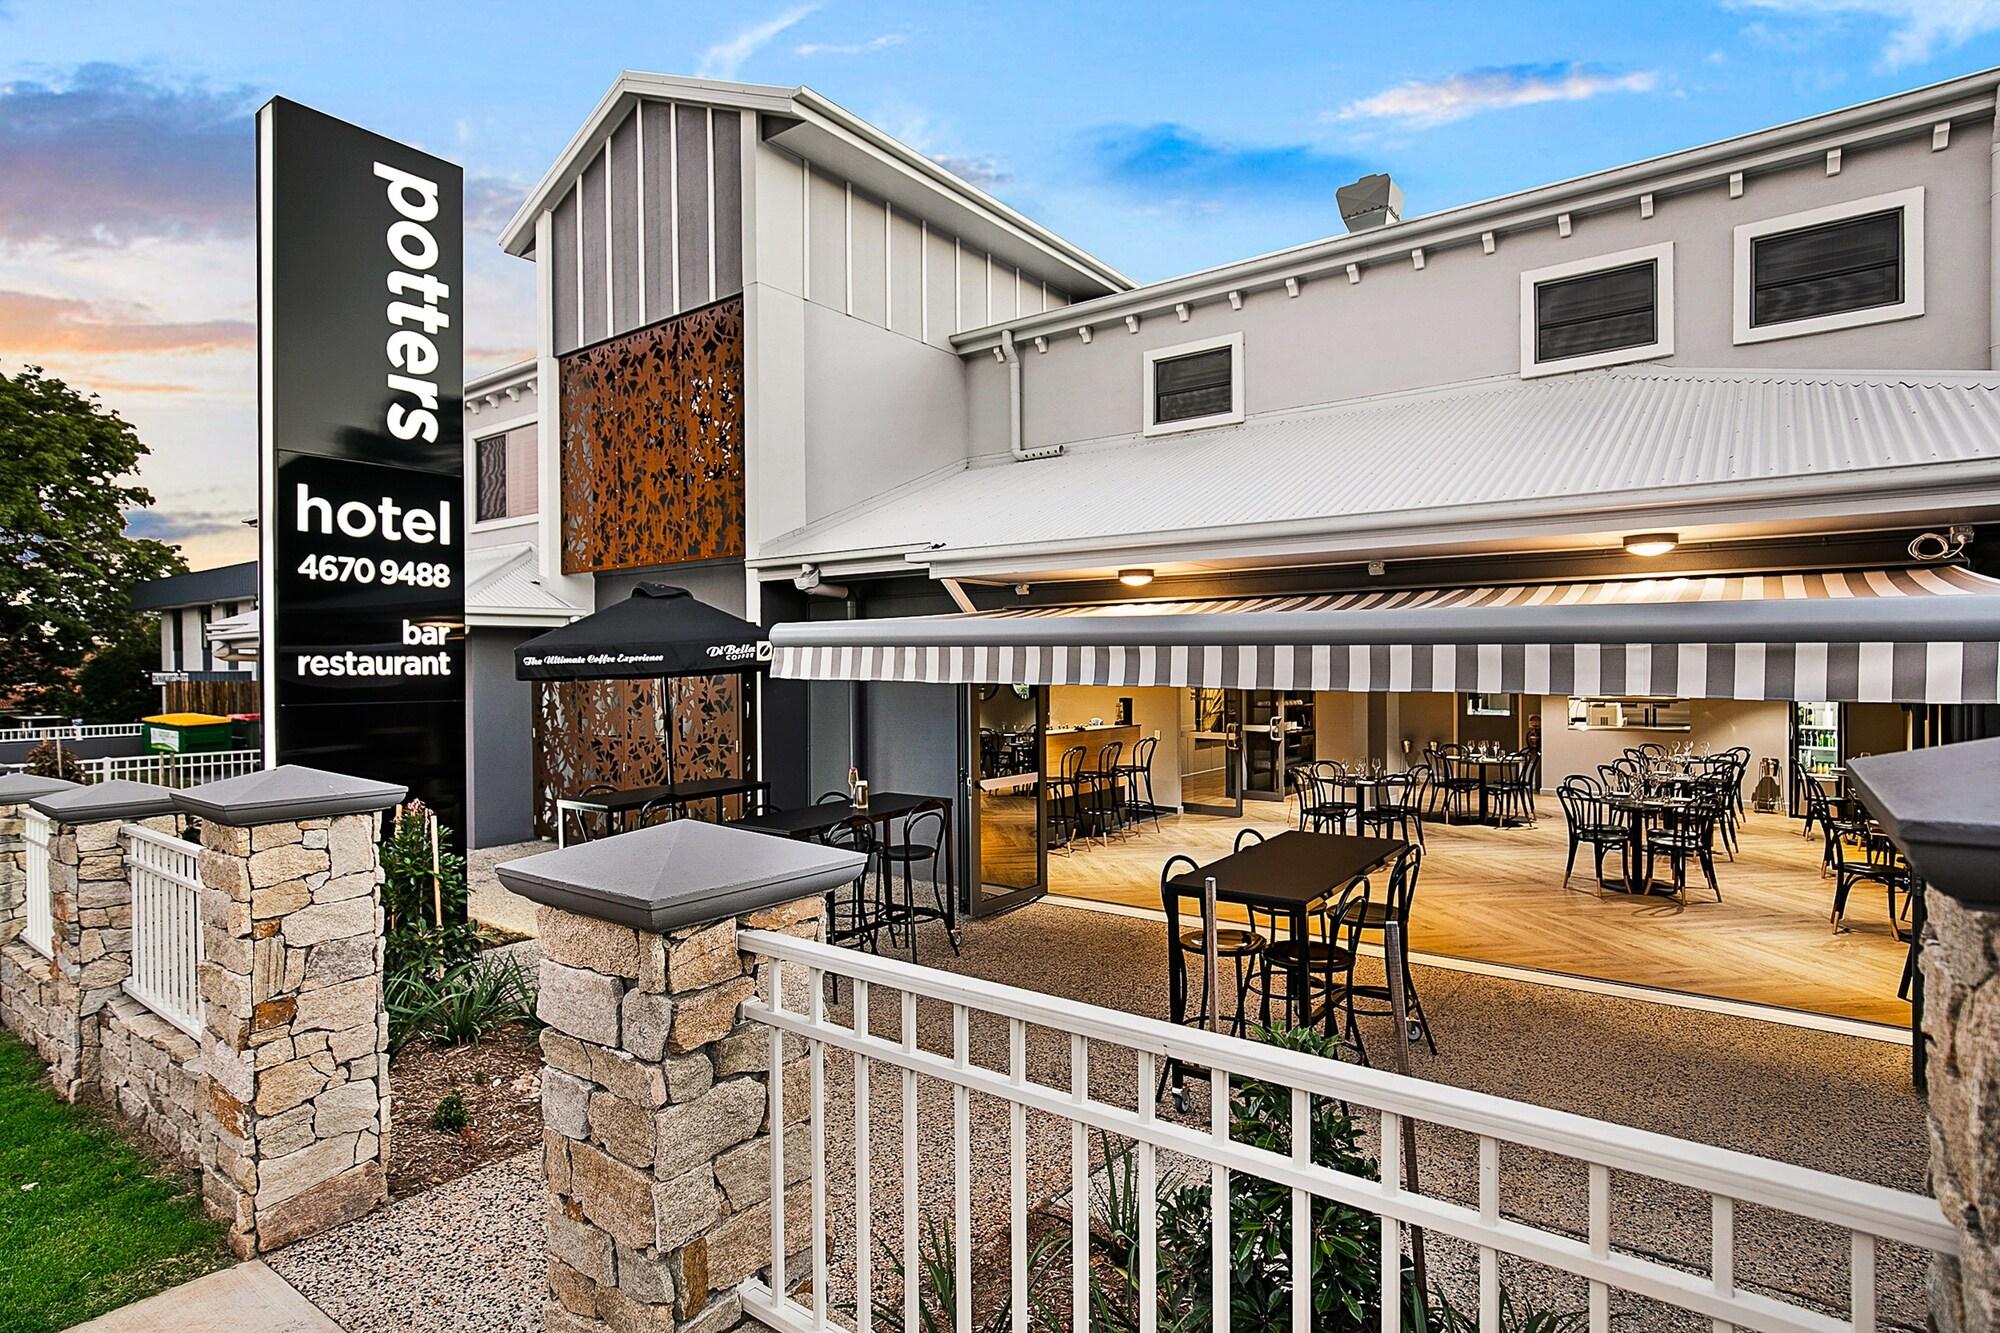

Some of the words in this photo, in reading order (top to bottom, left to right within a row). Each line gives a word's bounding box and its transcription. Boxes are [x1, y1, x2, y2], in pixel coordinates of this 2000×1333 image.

[373, 160, 449, 443] potters
[297, 483, 451, 545] hotel
[297, 553, 376, 584] 4670
[379, 559, 451, 588] 9488
[402, 619, 451, 645] bar
[523, 656, 543, 666] The
[543, 655, 586, 665] Ultimate
[587, 653, 616, 665] Coffee
[617, 653, 664, 664] Experience
[724, 644, 756, 655] Bella
[725, 652, 754, 661] COFFEE
[297, 651, 451, 676] restaurant
